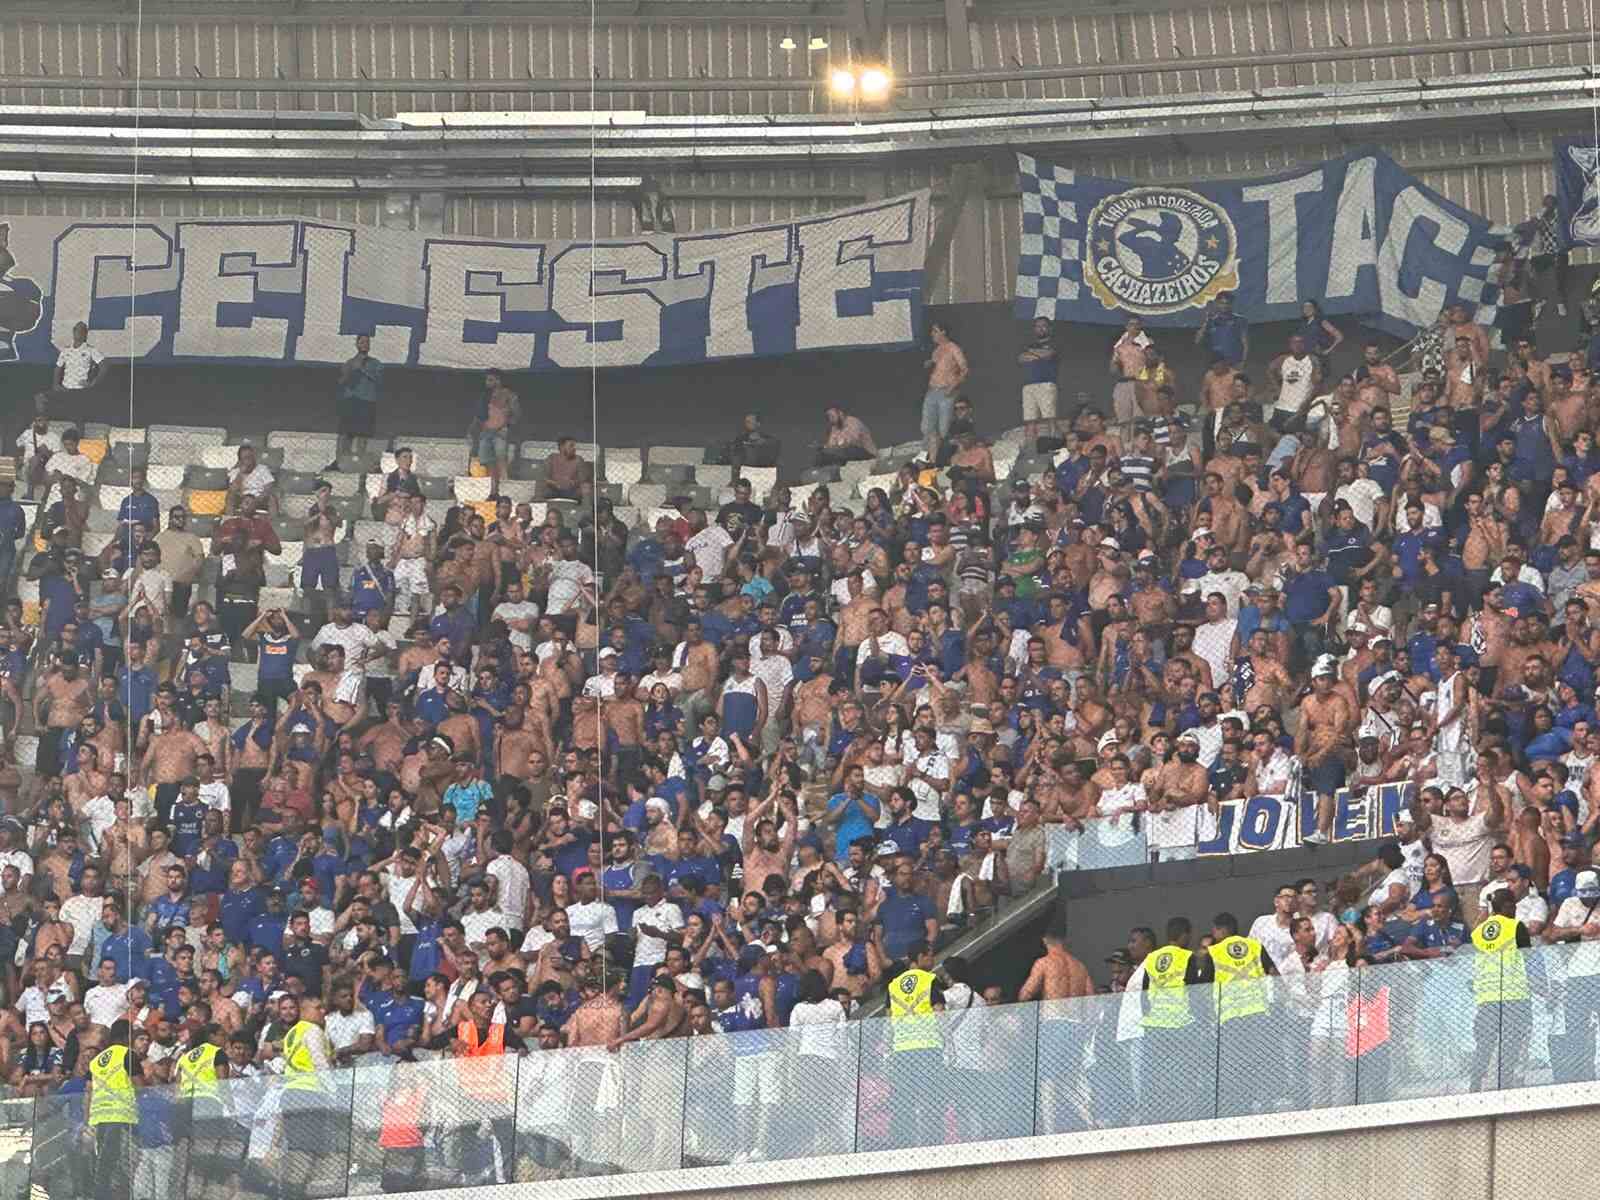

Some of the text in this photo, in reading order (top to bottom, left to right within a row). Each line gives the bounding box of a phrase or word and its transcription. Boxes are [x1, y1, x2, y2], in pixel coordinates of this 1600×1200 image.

[50, 198, 916, 369] CELESTE
[1096, 253, 1220, 305] CACHAZEIROS
[1242, 156, 1471, 328] TAC
